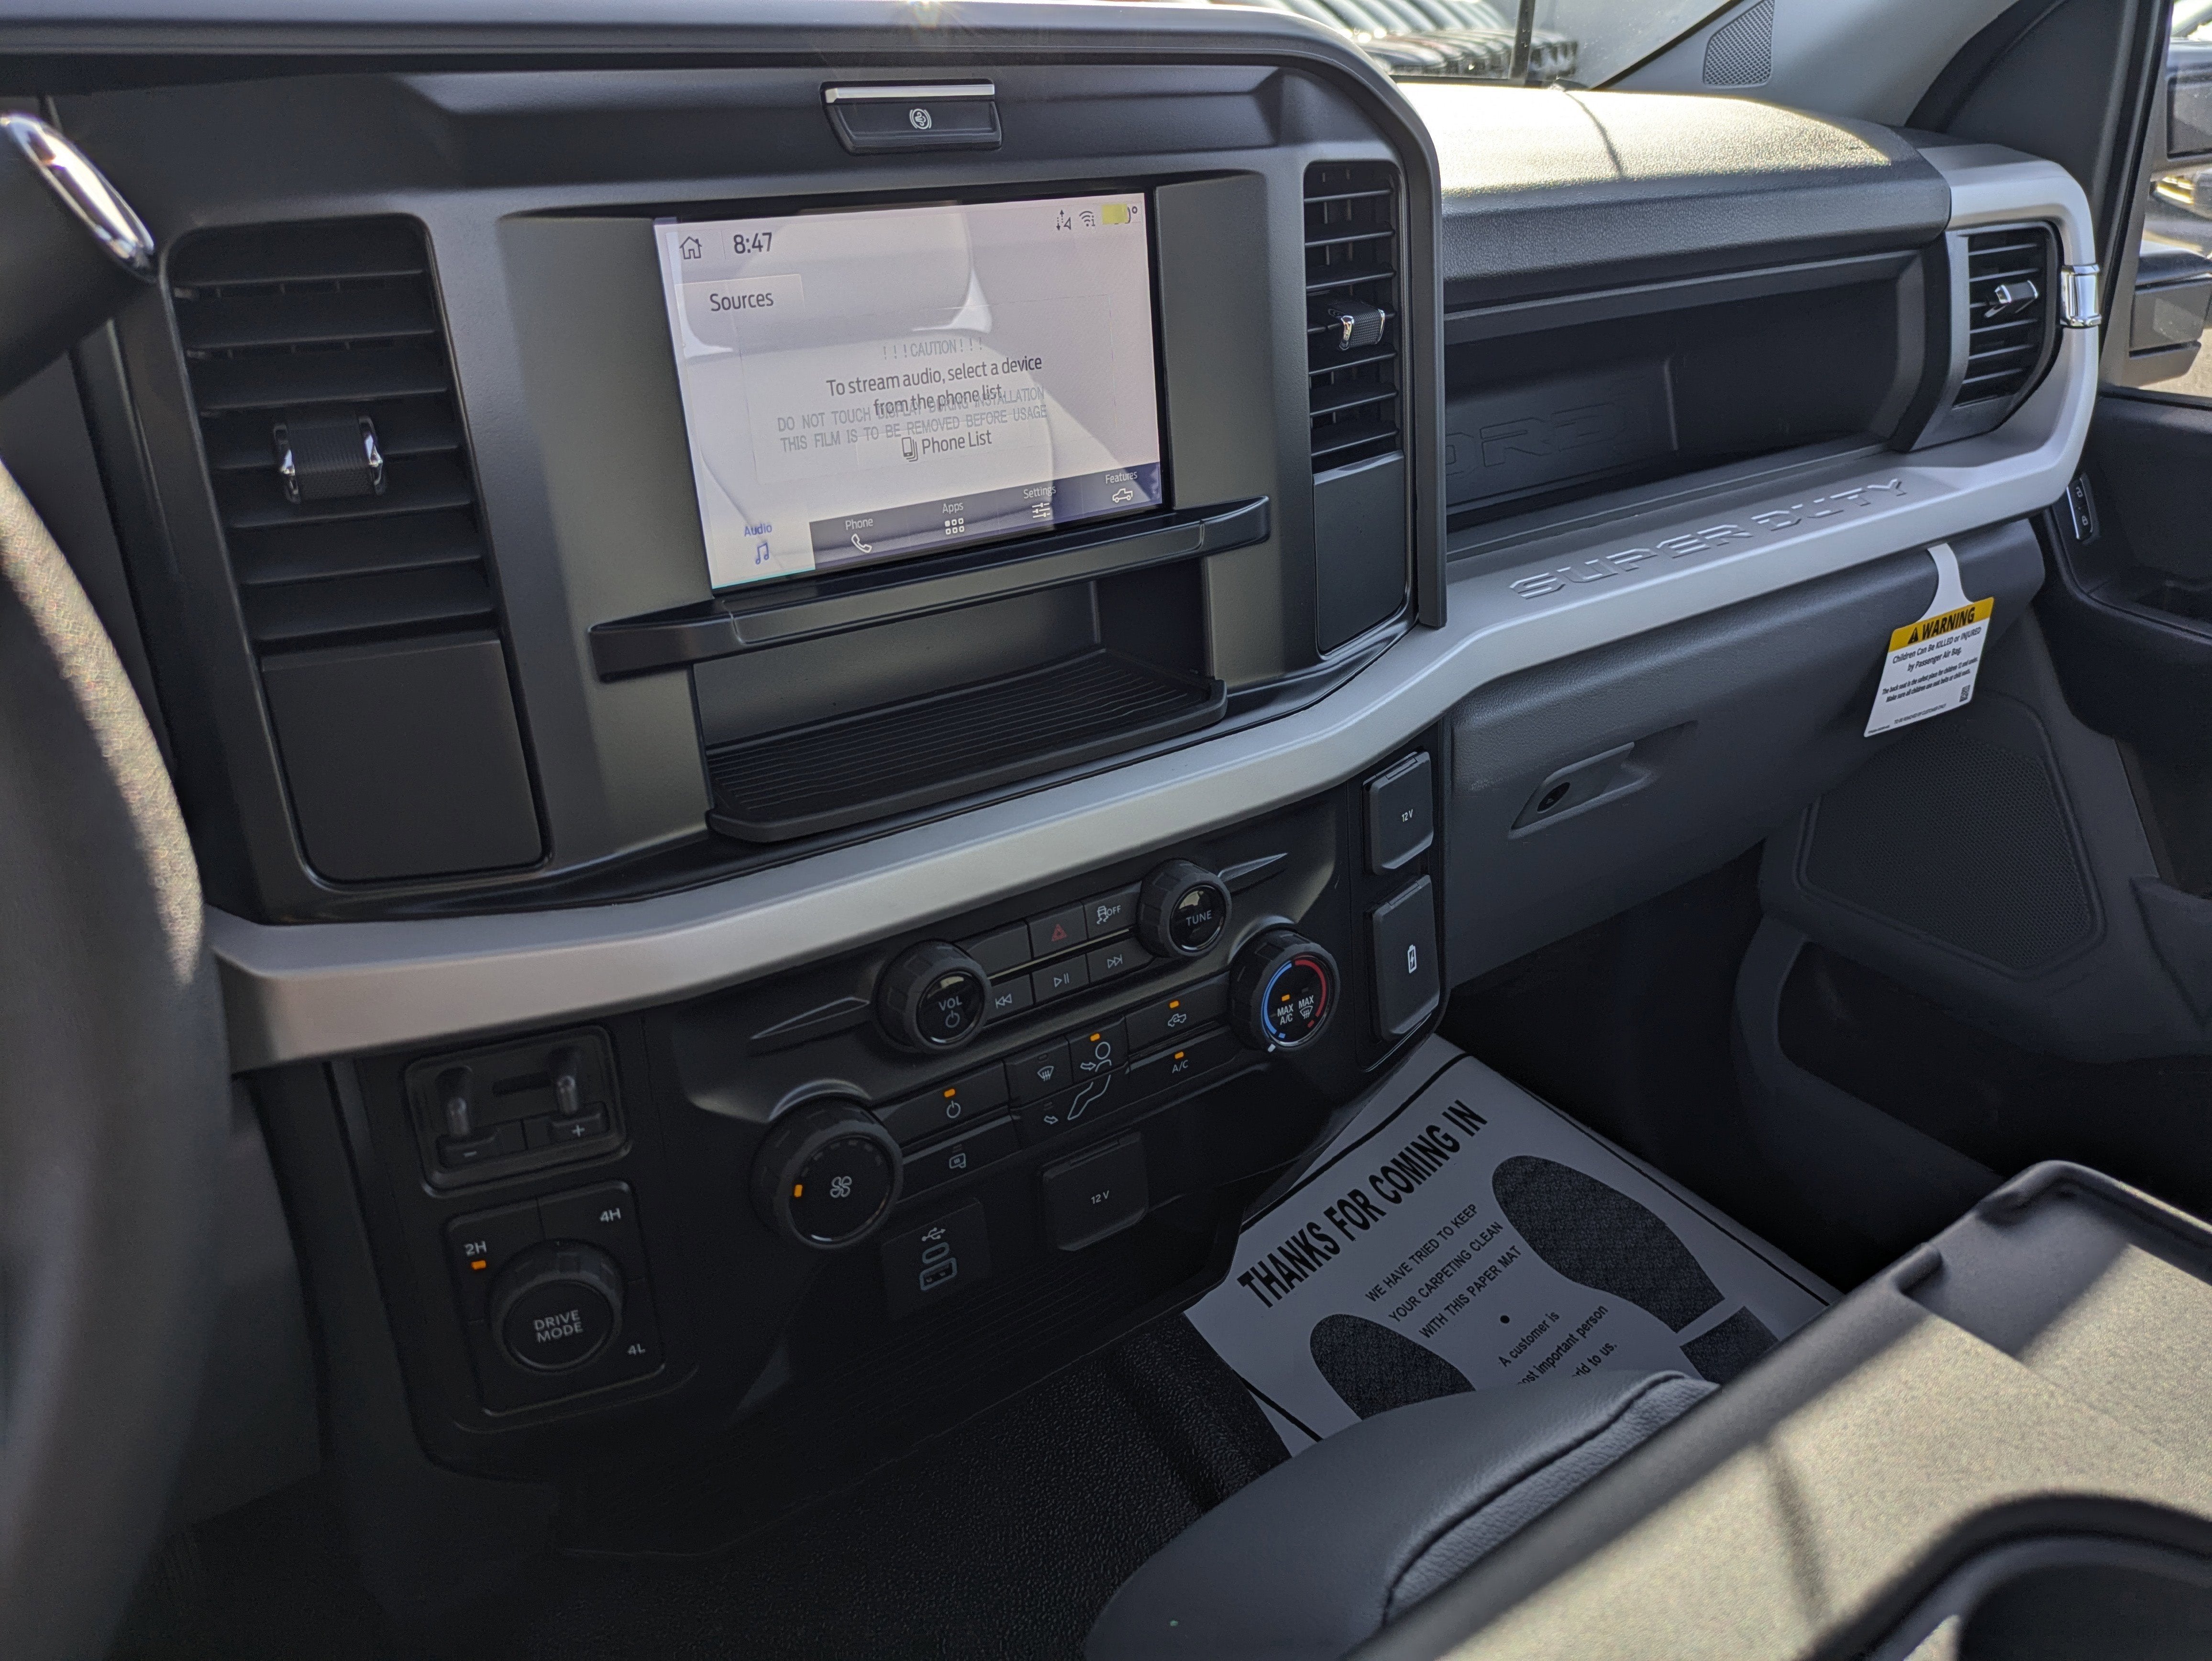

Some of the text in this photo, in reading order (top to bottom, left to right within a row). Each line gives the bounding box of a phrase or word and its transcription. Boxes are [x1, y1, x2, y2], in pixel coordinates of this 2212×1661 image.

[733, 232, 773, 255] 8:47
[709, 292, 774, 312] Sources
[826, 355, 1042, 397] To stream audio, select a device
[777, 416, 795, 432] DO
[802, 412, 825, 430] NOT
[831, 407, 872, 425] TOUCH
[877, 402, 921, 420] DISPLAY
[974, 386, 1045, 408] INSTALLATION
[873, 398, 908, 416] from
[910, 393, 934, 410] the
[937, 389, 979, 411] phone
[780, 404, 1048, 453] THIS FILM IS TO BE REMOVED BEFORE USAGE
[921, 430, 992, 454] Phone List
[1105, 471, 1138, 485] Features
[1023, 484, 1056, 499] Settings
[942, 501, 964, 514] Apps
[744, 522, 773, 537] Audio
[845, 517, 874, 531] Phone
[1508, 478, 1907, 600] SUPER DUTY
[1922, 607, 1975, 641] WARNING
[1892, 626, 1982, 664] Children Can Be KILLED or INJURED
[1907, 663, 1915, 673] by
[1915, 653, 1943, 669] Passenger
[1942, 649, 1951, 659] Air
[1105, 905, 1122, 918] OFF
[1185, 910, 1213, 927] TUNE
[938, 996, 963, 1012] VOL
[1276, 1003, 1294, 1017] MAX
[1298, 995, 1315, 1008] MAX
[1279, 1013, 1294, 1026] A/C
[1172, 1059, 1189, 1074] A/C
[599, 1207, 622, 1222] 4H
[1237, 1099, 1488, 1308] THANKS FOR COMING IN
[463, 1240, 487, 1257] 2H
[1365, 1204, 1478, 1302] WE HAVE TRIED TO KEEP
[1388, 1221, 1504, 1322] YOUR CARPETING CLEAN
[1418, 1245, 1521, 1339] WITH THIS PAPER MAT
[533, 1309, 581, 1332] DRIVE
[536, 1321, 584, 1343] MODE
[627, 1343, 646, 1356] 4L
[1498, 1311, 1560, 1367] A customer is
[1517, 1305, 1609, 1385] ost important person
[1586, 1354, 1602, 1366] to
[1599, 1342, 1618, 1356] us.
